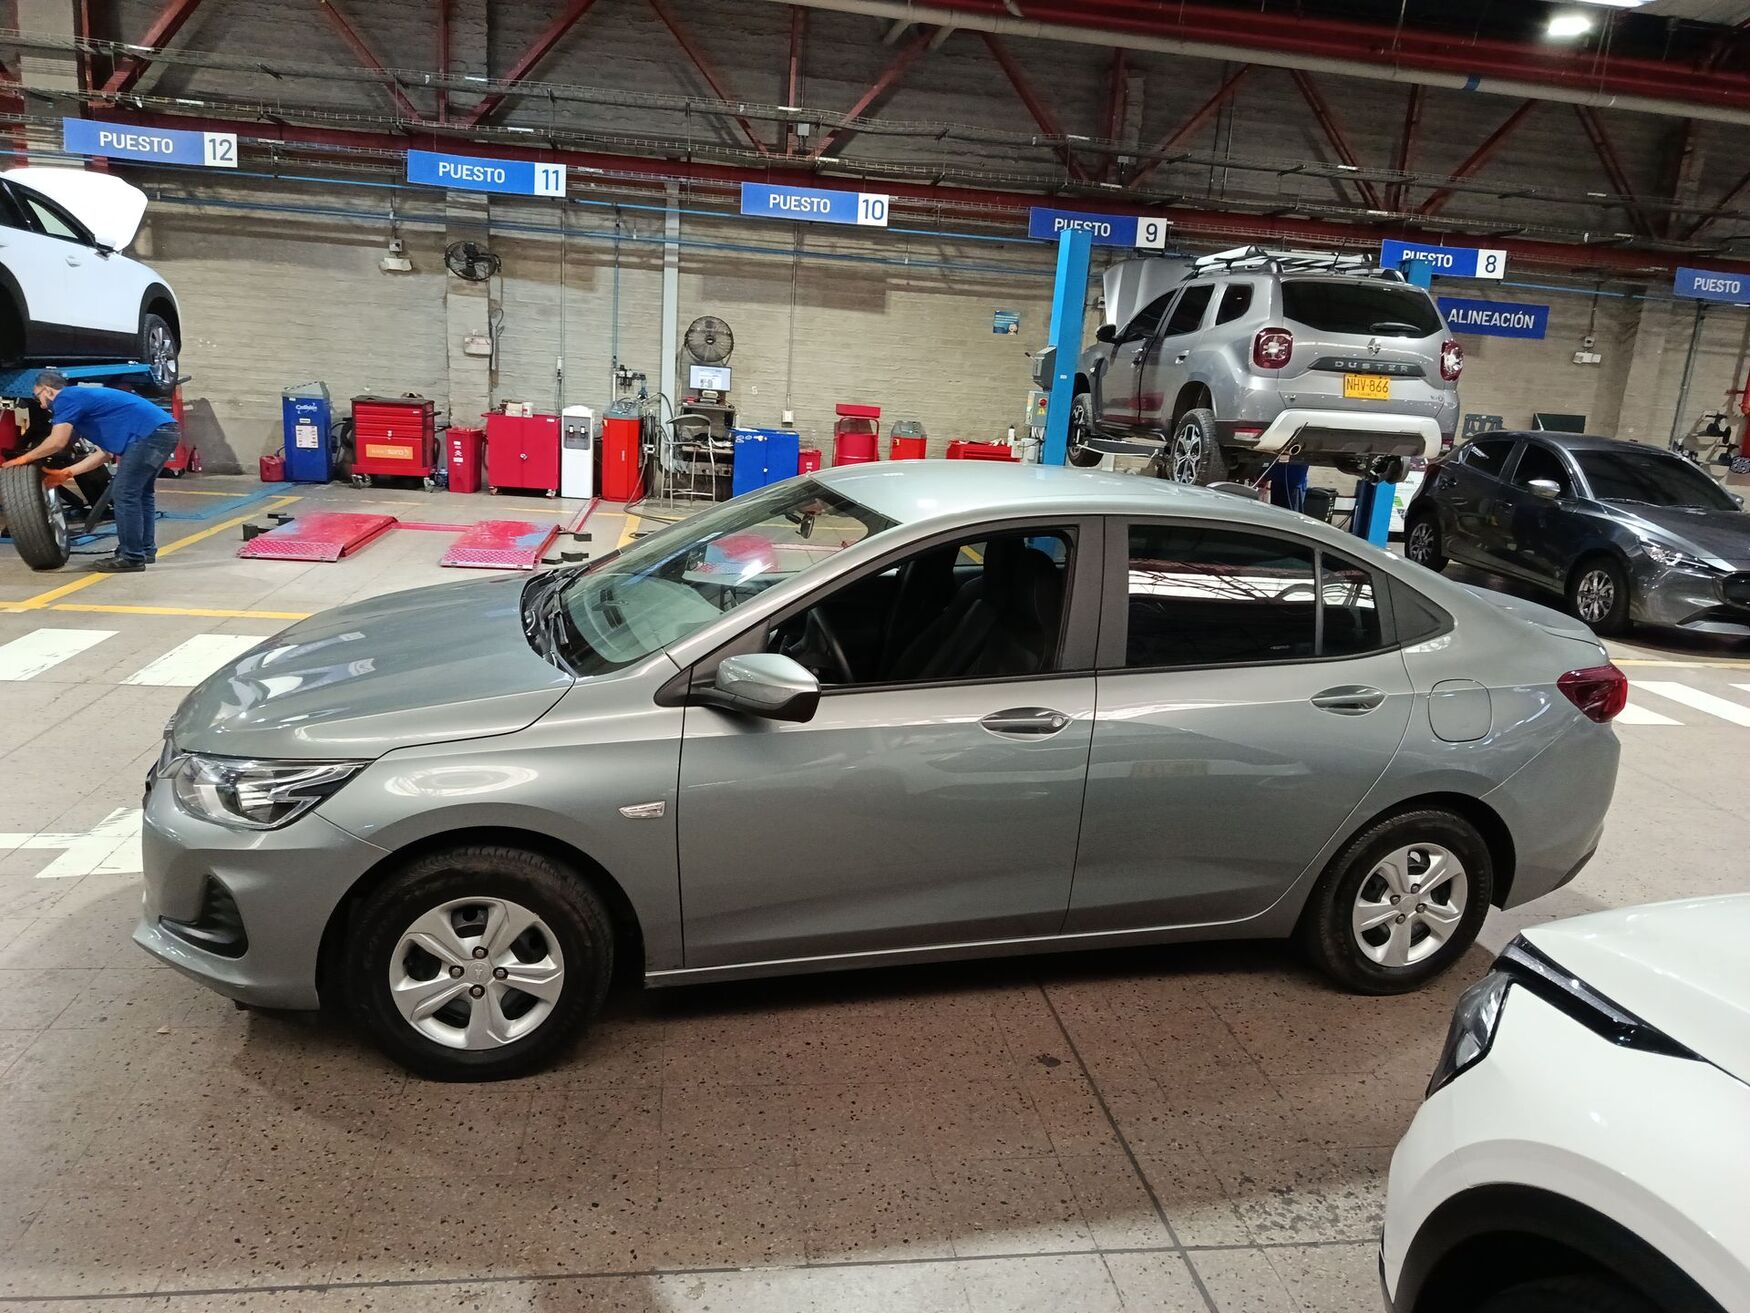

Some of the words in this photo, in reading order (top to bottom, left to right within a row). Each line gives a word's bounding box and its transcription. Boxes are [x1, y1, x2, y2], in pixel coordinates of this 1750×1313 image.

[99, 131, 174, 154] PUESTO
[208, 138, 233, 161] 12
[438, 161, 506, 183] PUESTO
[542, 168, 559, 191] 11
[769, 193, 831, 213] PUESTO
[862, 199, 885, 220] 10
[1145, 223, 1158, 243] 9
[1485, 254, 1497, 273] 8
[1693, 277, 1741, 294] PUESTO
[1448, 308, 1535, 329] ALINEACIÓN
[1334, 360, 1409, 373] DUSTER
